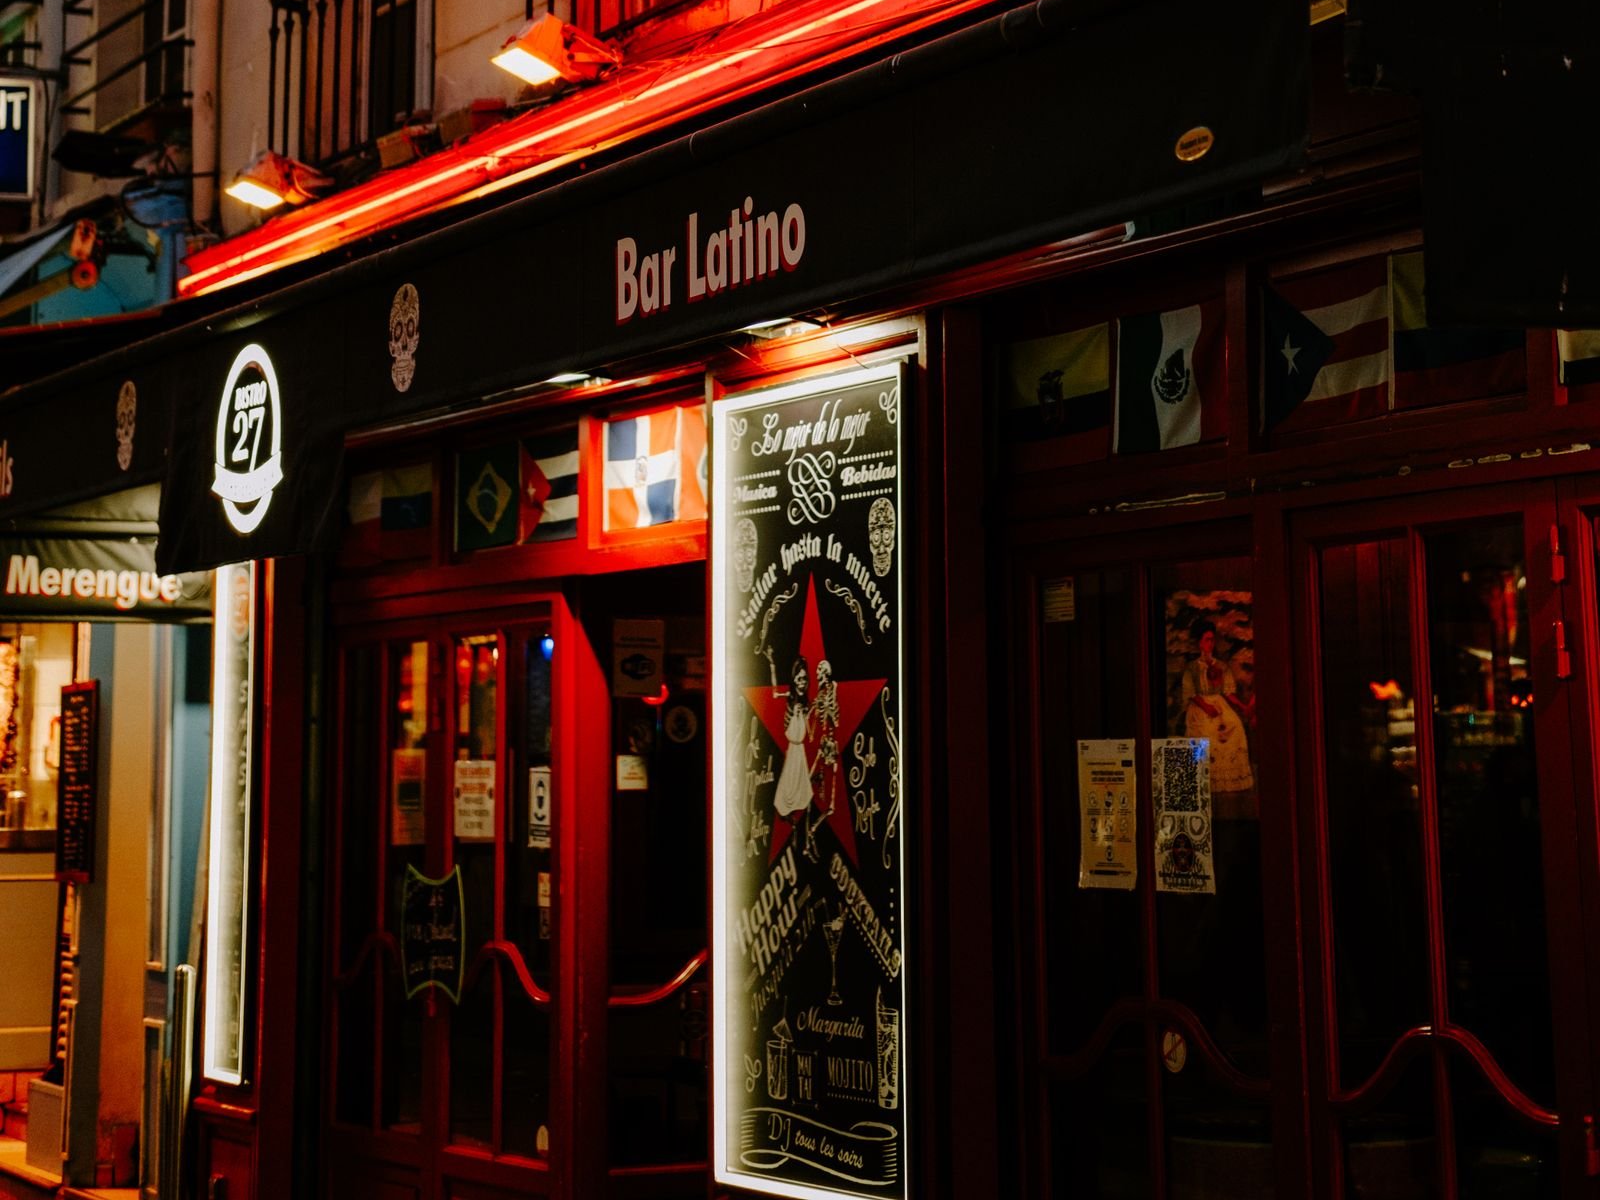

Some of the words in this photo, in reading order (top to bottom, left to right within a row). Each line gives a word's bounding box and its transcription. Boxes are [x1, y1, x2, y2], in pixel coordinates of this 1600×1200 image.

[616, 237, 676, 324] Bar
[688, 196, 805, 300] Latino
[234, 380, 267, 411] BISTRO
[232, 406, 265, 472] 27
[840, 462, 896, 487] Bebidas
[6, 554, 184, 611] Merengue
[780, 532, 822, 576] hasta
[826, 532, 842, 563] la
[845, 552, 893, 634] muerte
[736, 846, 798, 956] Happy
[752, 887, 798, 976] Hour
[797, 1054, 812, 1075] MAI
[798, 1076, 812, 1100] TAI
[827, 1055, 873, 1092] MOJITO
[768, 1112, 791, 1152] DJ
[795, 1129, 817, 1151] tous
[820, 1136, 834, 1158] les
[838, 1147, 863, 1169] soirs
